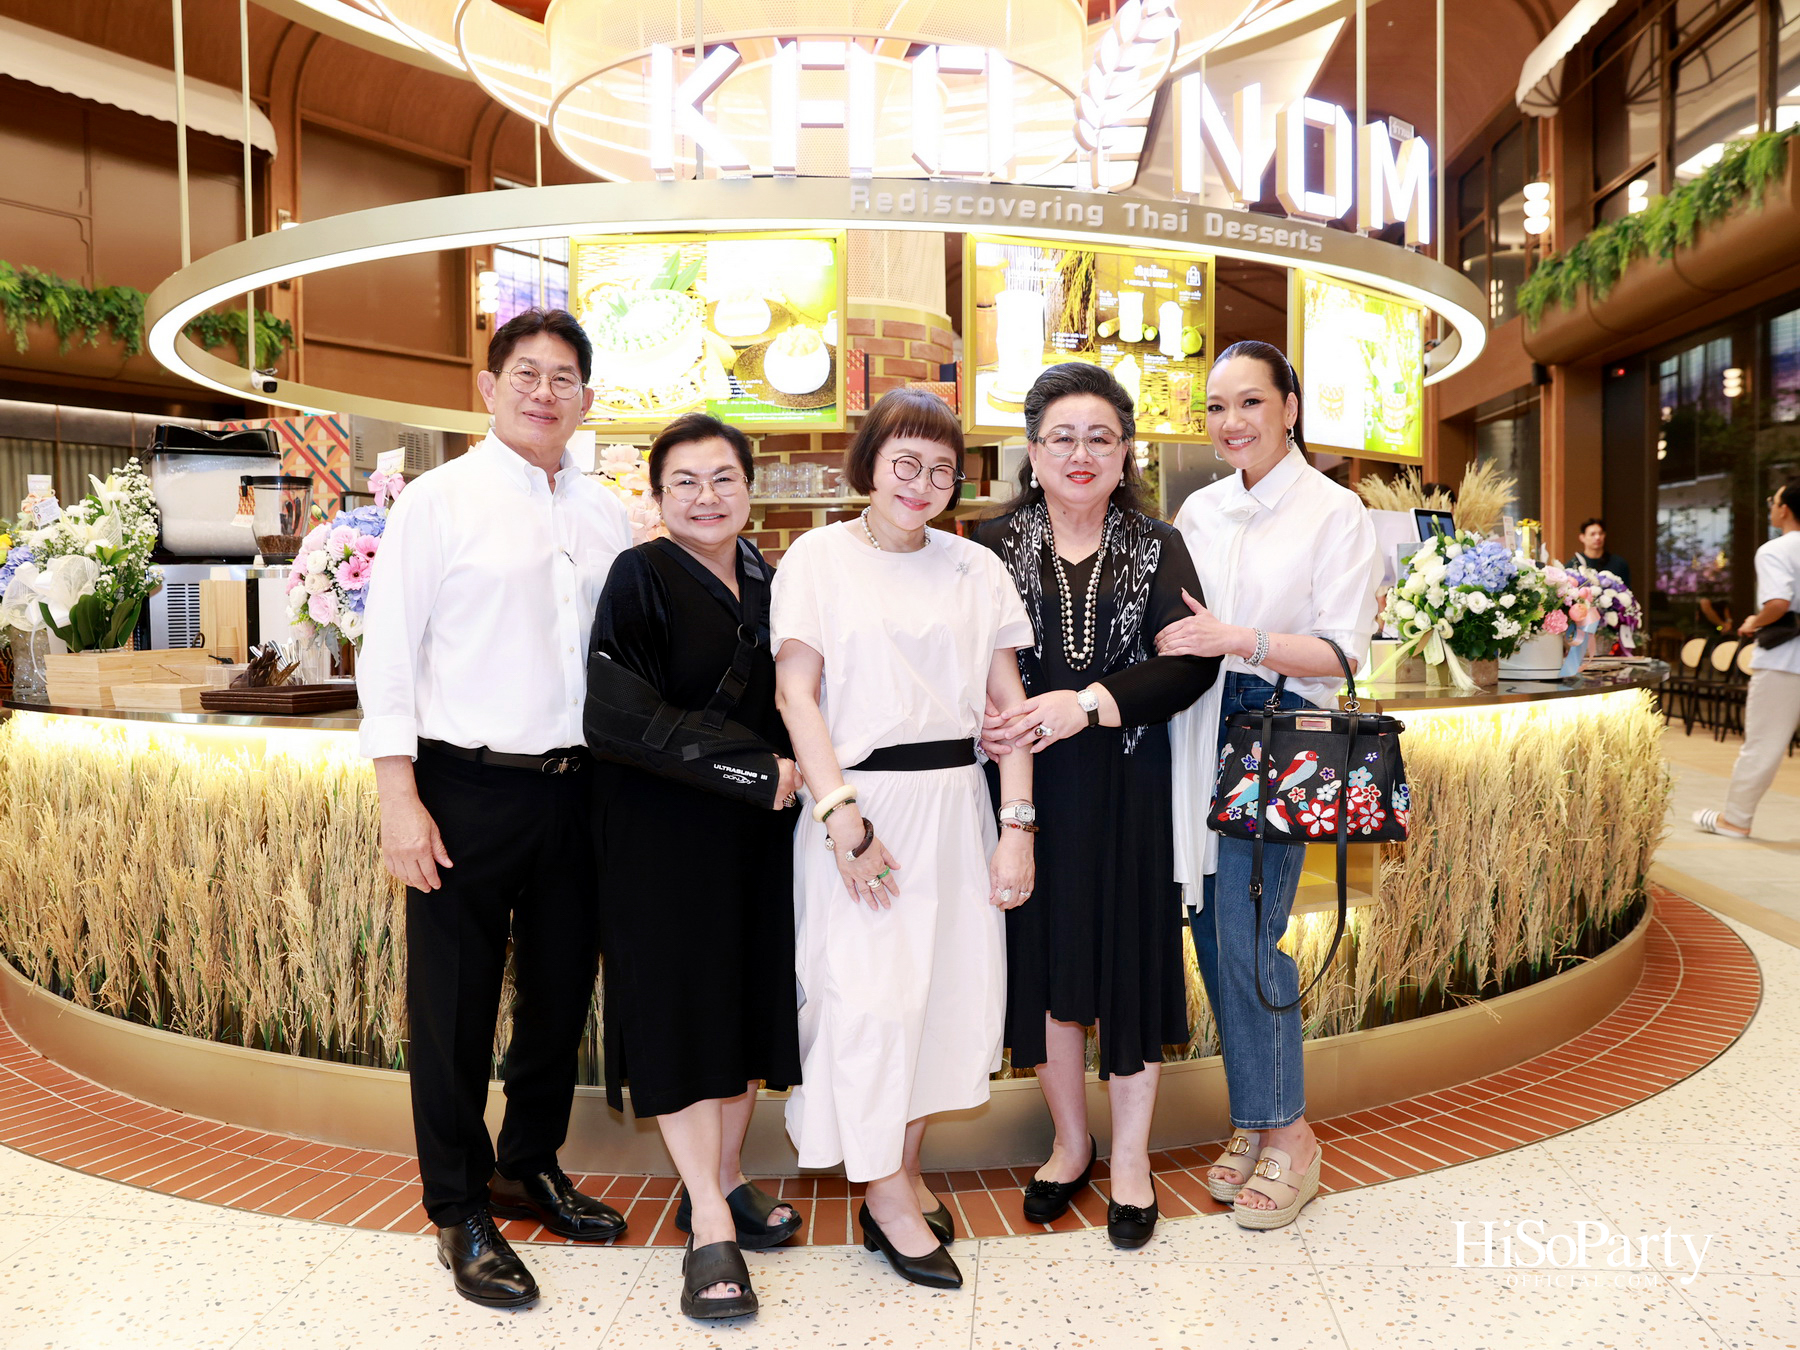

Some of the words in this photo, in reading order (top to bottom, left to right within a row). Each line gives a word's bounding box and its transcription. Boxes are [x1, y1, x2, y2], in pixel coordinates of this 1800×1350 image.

[1173, 72, 1430, 244] NOM
[850, 185, 1104, 227] Rediscovering
[1122, 202, 1188, 233] Thai
[1206, 212, 1324, 253] Desserts
